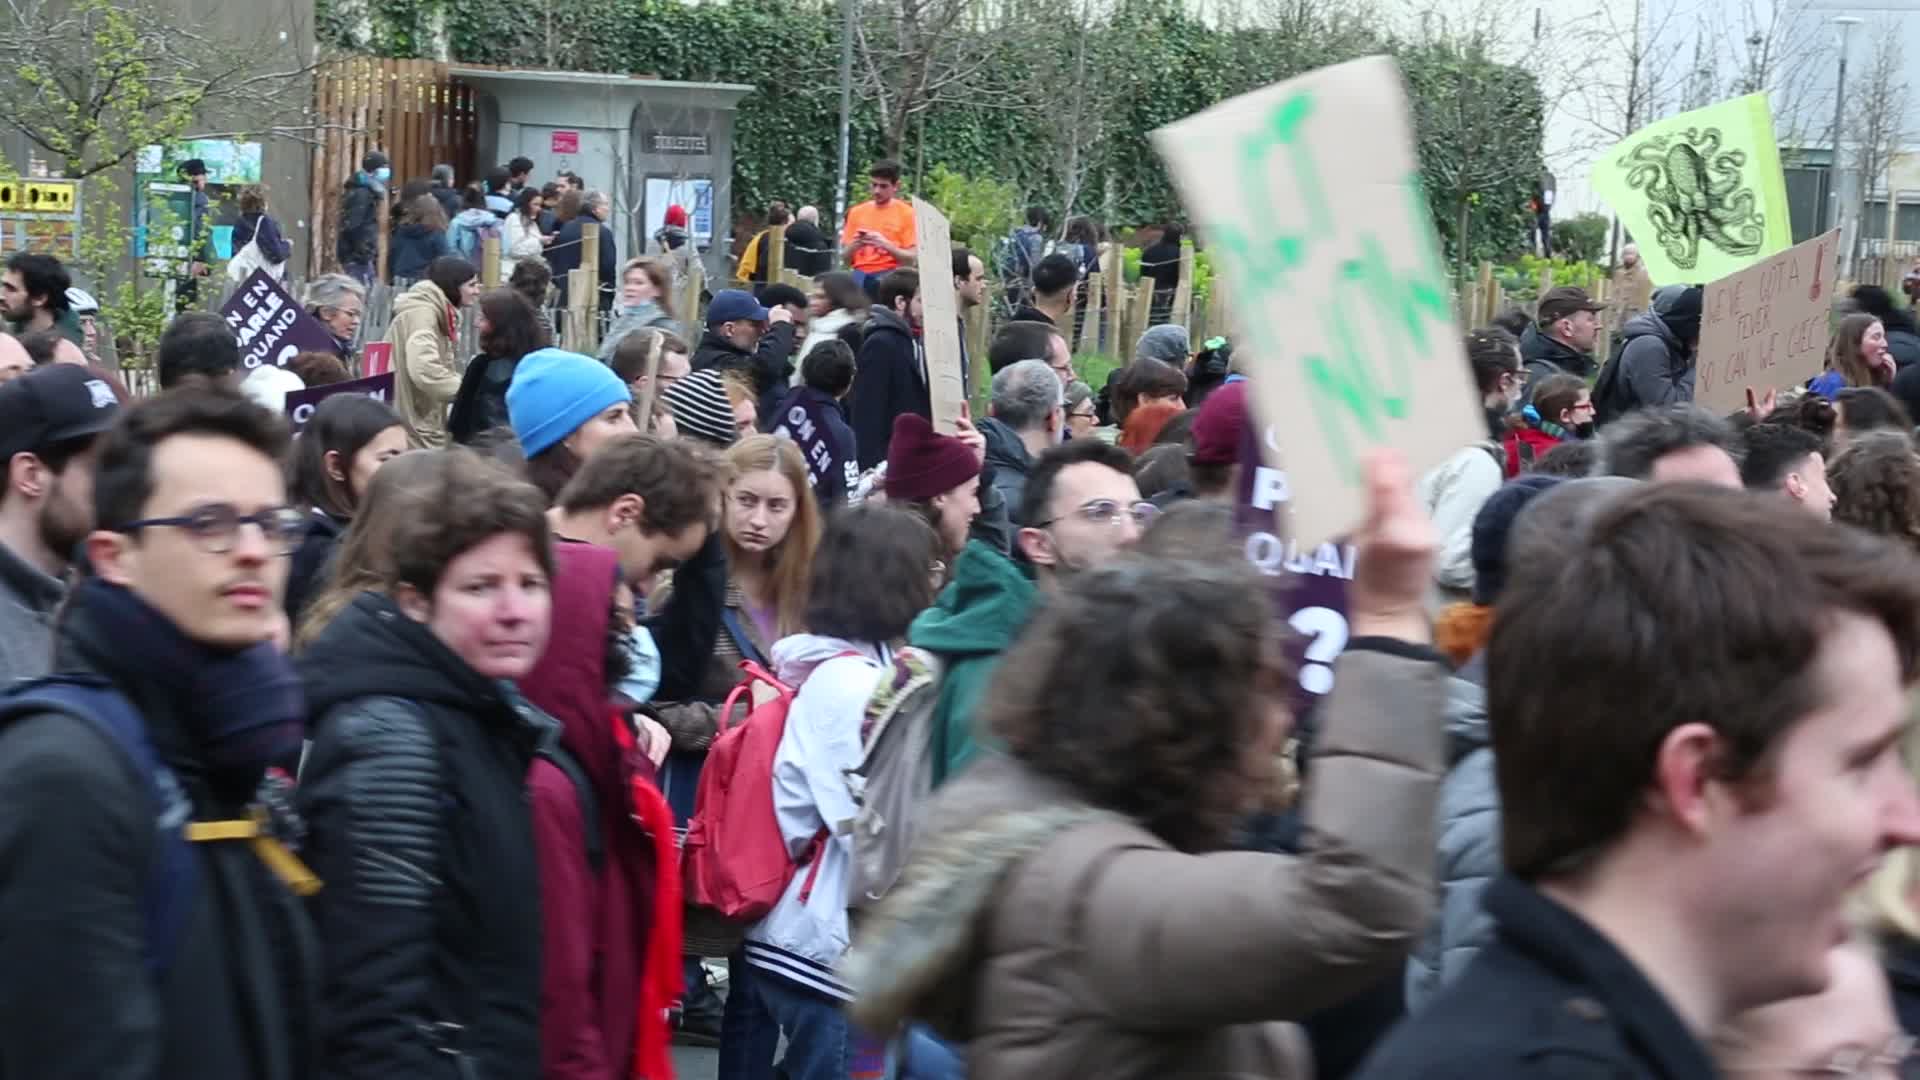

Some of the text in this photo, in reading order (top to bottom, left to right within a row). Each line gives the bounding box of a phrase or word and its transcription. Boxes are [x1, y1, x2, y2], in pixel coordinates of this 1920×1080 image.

[243, 279, 270, 309] EN
[243, 308, 297, 369] QUAND
[787, 405, 817, 442] ON
[811, 439, 833, 473] EN
[1287, 606, 1350, 695] ?
